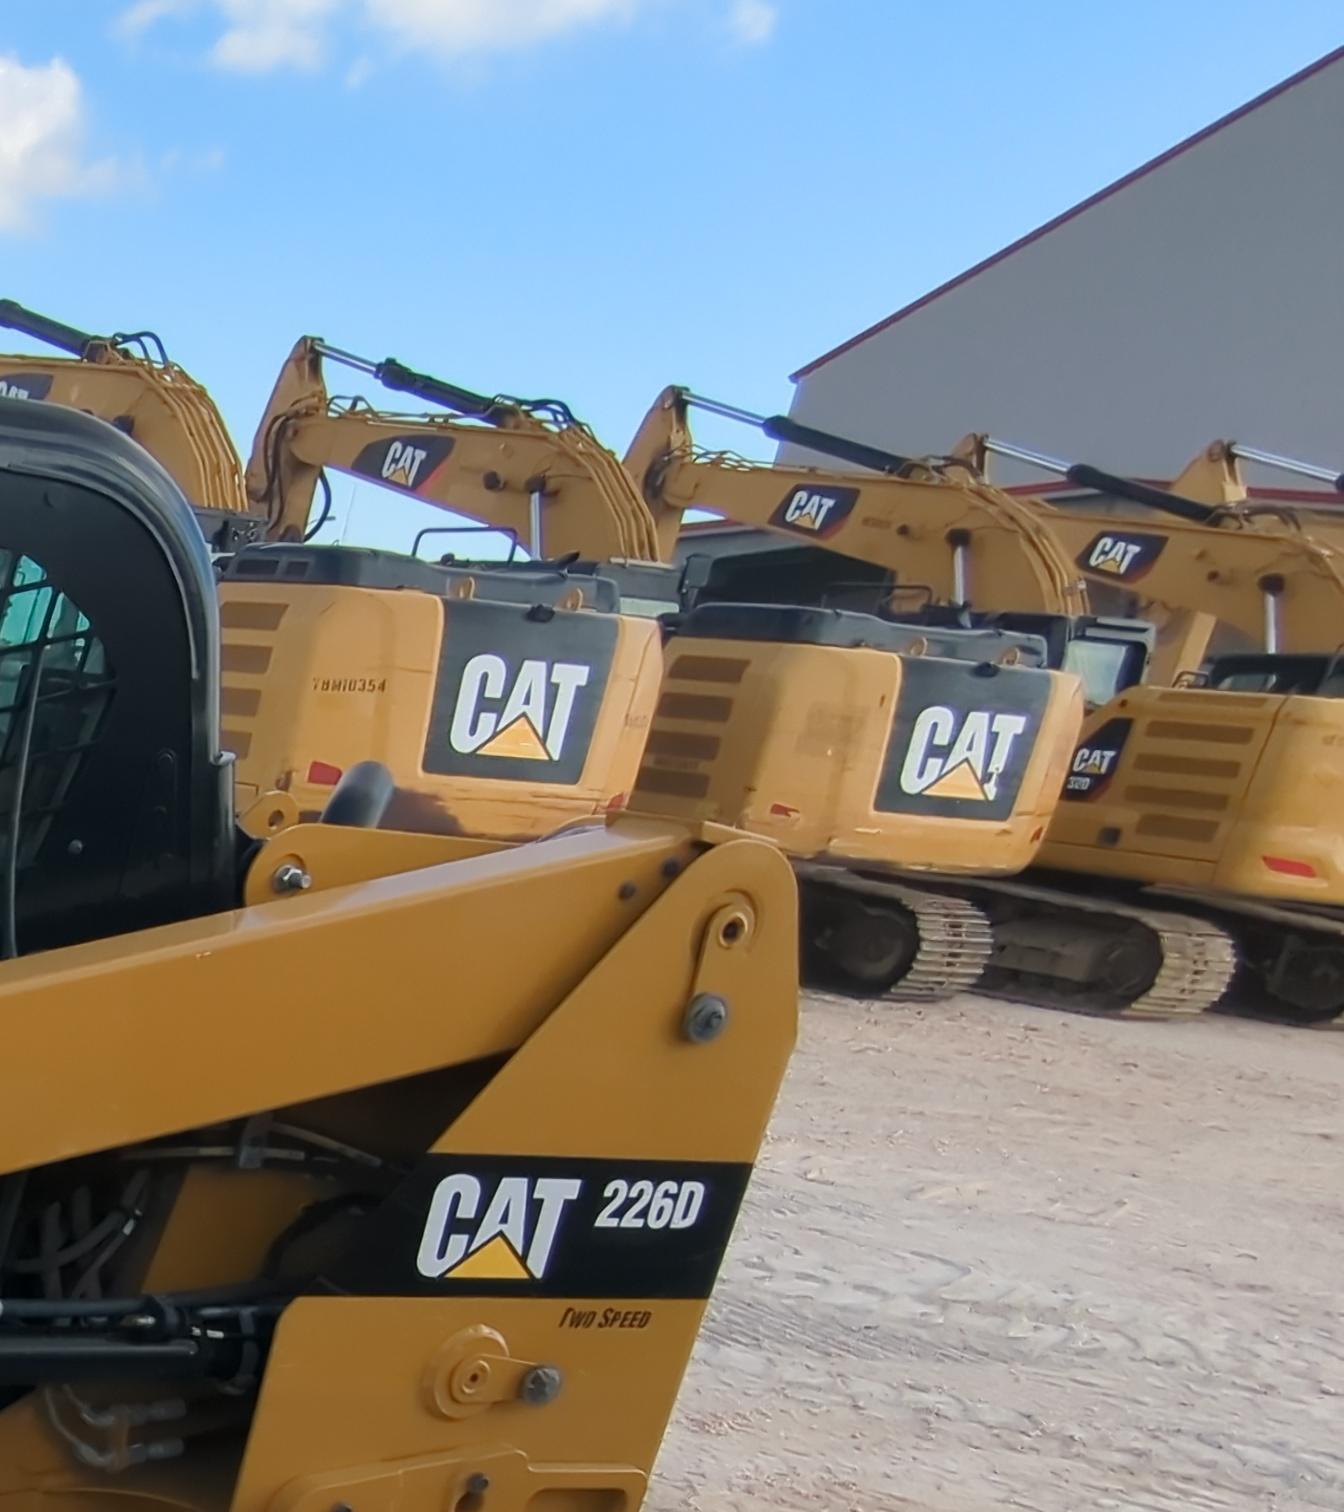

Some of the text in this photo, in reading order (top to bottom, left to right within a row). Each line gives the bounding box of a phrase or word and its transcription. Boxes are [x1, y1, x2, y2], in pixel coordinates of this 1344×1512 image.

[382, 441, 427, 487] CAT
[785, 490, 836, 531] CAT
[1089, 536, 1141, 574] CAT
[450, 653, 590, 761] CAT
[900, 706, 1027, 801] CAT
[1073, 748, 1117, 775] CAT
[416, 1173, 706, 1280] CAT 226D
